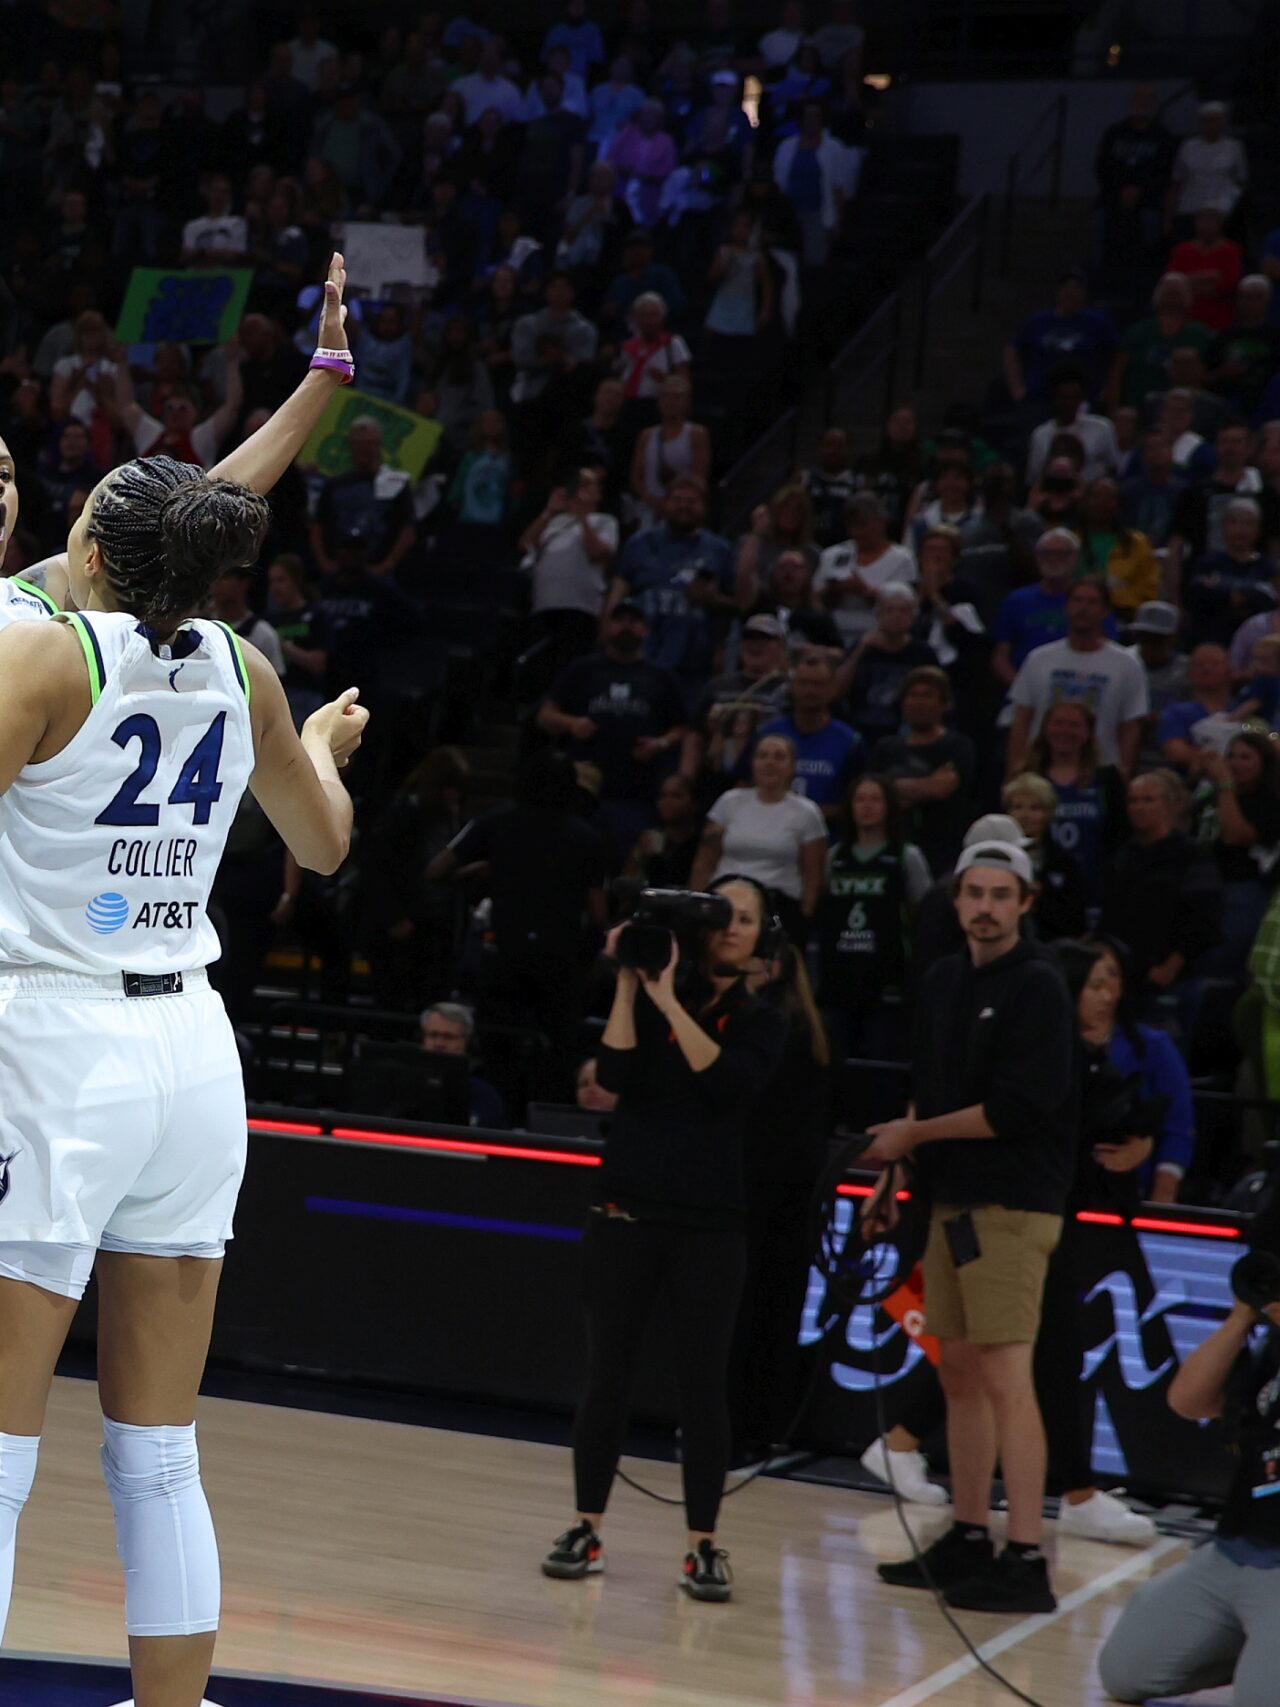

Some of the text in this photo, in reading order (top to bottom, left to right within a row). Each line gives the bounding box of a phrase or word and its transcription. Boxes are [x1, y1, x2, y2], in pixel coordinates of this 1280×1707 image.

[94, 711, 227, 826] 24
[107, 838, 197, 877] COLLIER
[132, 901, 199, 929] AT&T
[847, 901, 868, 930] 6
